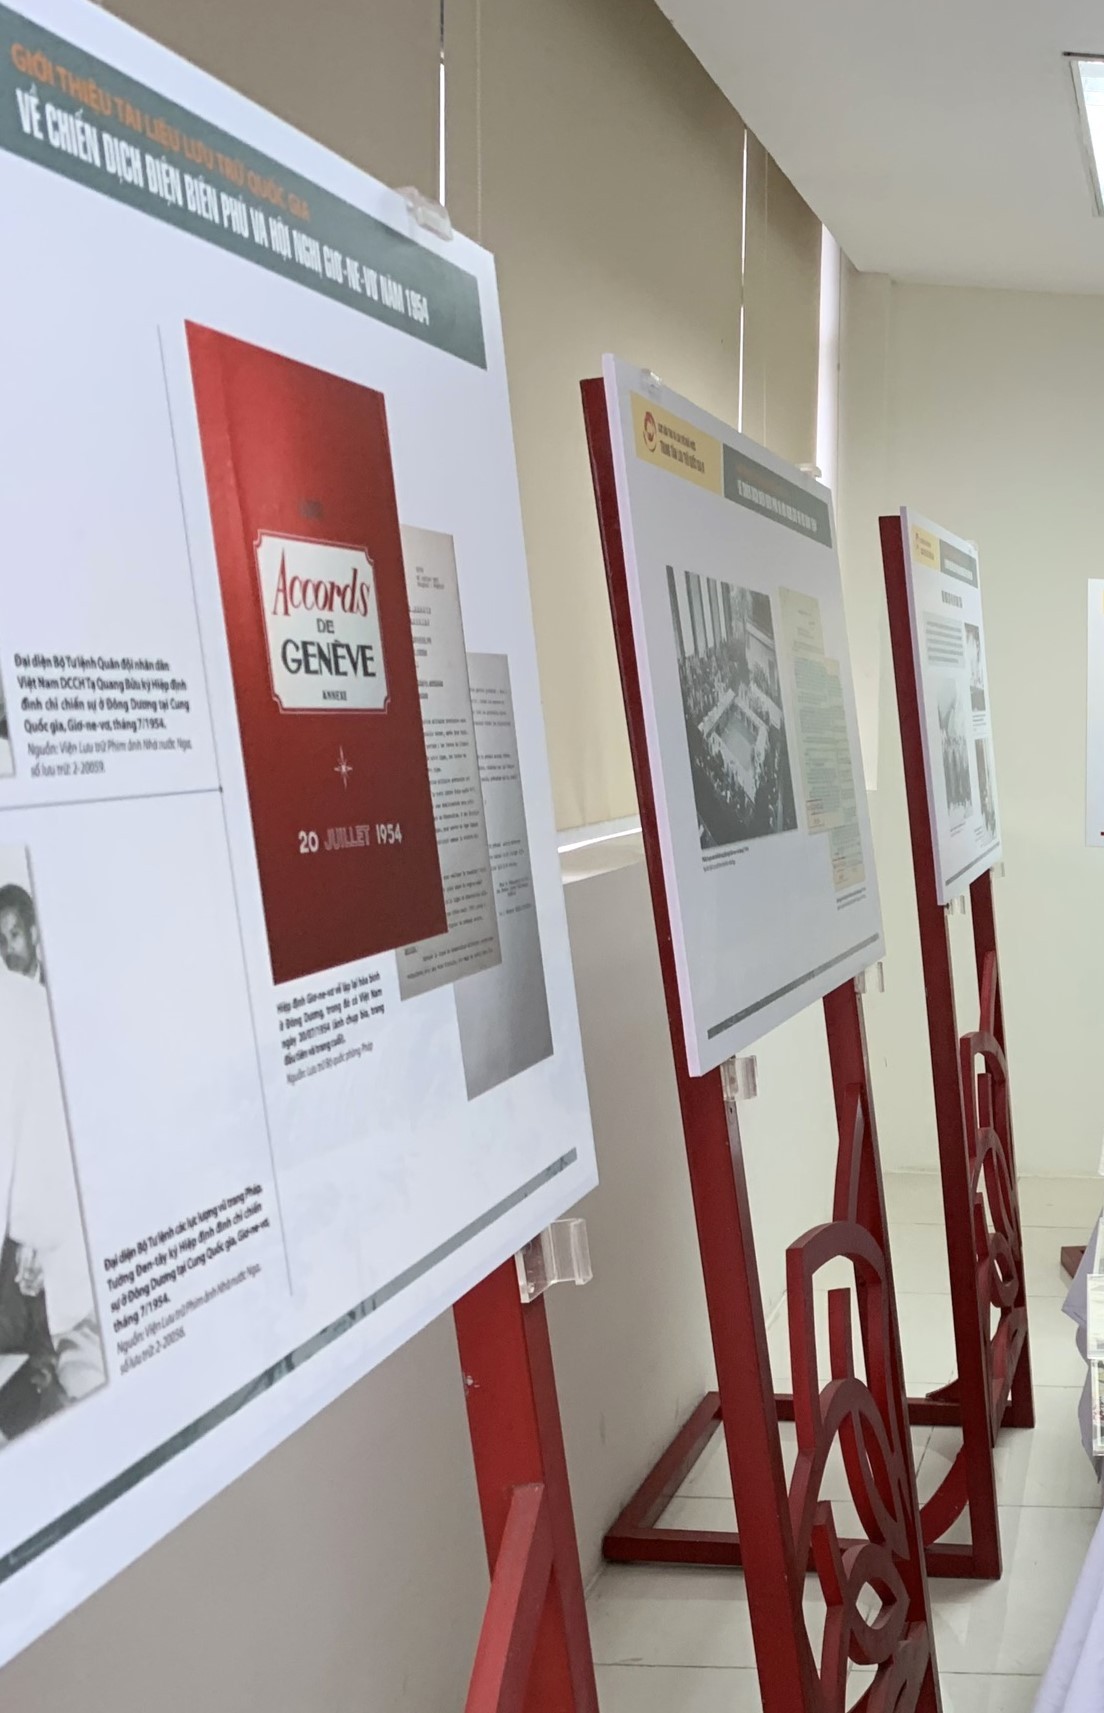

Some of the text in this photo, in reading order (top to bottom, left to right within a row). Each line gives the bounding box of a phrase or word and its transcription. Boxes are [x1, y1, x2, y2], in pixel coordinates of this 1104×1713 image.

[272, 546, 370, 617] Accords
[316, 617, 335, 634] DE
[280, 638, 377, 678] GENÈVE
[298, 823, 402, 853] 20 JUILLET 1954
